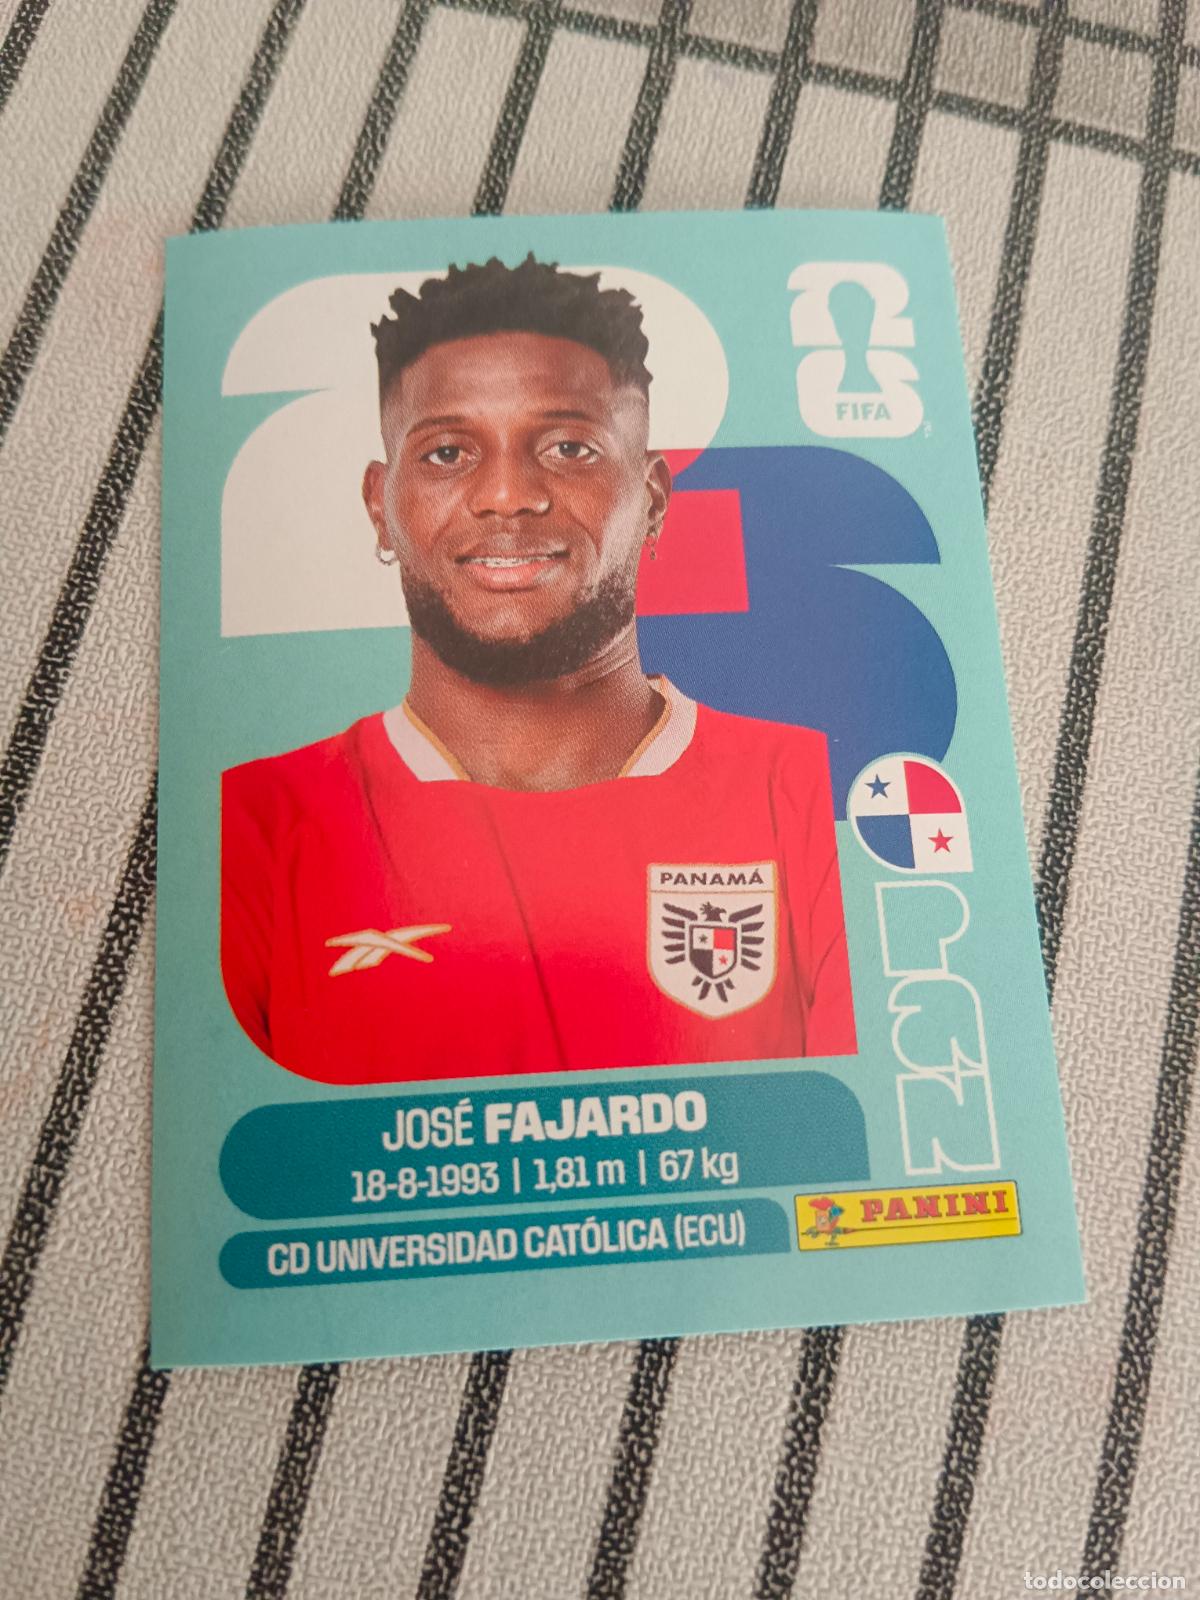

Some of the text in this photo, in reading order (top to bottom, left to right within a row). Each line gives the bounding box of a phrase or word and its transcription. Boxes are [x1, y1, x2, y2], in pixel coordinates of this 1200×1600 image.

[836, 402, 892, 421] FIFA
[660, 868, 764, 886] PANAMÁ
[382, 1090, 708, 1152] JOSÉ FAJARDO
[351, 1161, 499, 1203] 18-8-1993
[533, 1156, 591, 1194] 1,81
[597, 1159, 626, 1186] m
[659, 1150, 694, 1181] 67
[701, 1148, 739, 1185] kg
[860, 1189, 1010, 1223] PANINI
[267, 1210, 746, 1277] CD UNIVERSIDAD CATÓLICA (ECU)
